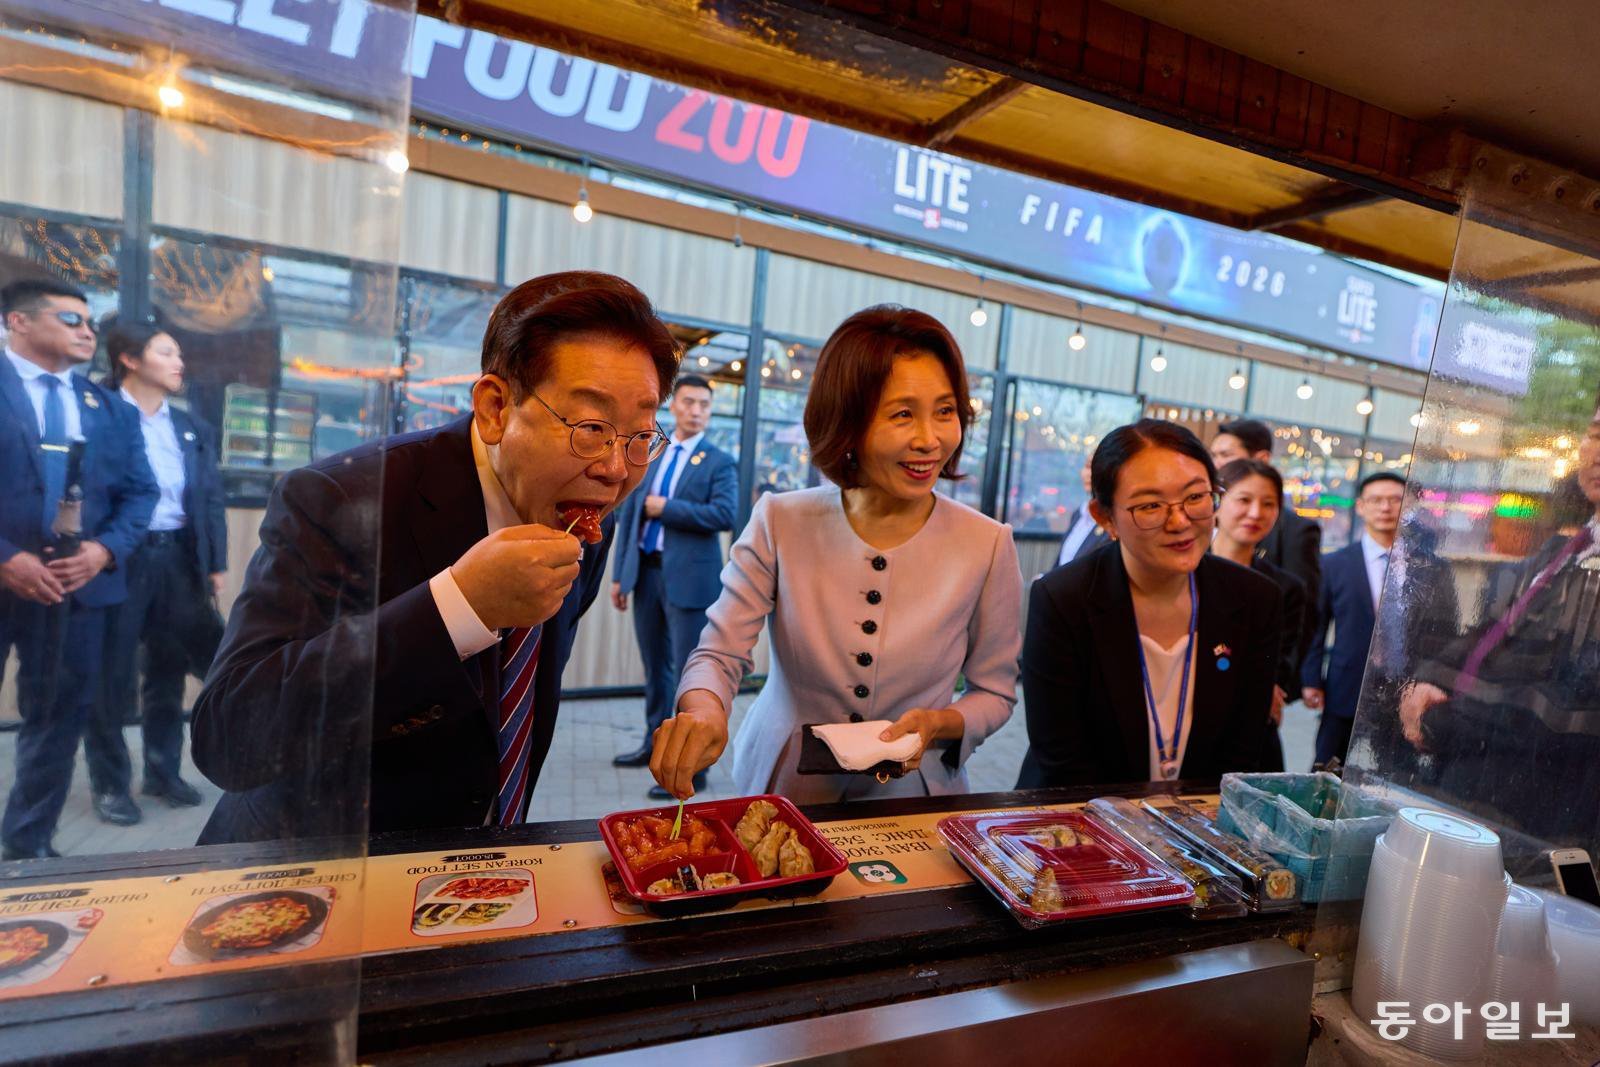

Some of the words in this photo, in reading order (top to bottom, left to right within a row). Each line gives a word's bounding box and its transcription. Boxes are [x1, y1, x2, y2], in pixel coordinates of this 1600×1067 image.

[894, 147, 972, 215] LITE
[1020, 194, 1103, 245] FIFA
[1216, 255, 1286, 297] 2026
[1337, 288, 1378, 332] LITE
[871, 828, 929, 843] ДАНС:
[885, 841, 933, 855] IBAN
[407, 865, 448, 875] FOOD
[451, 862, 481, 872] SET
[485, 857, 543, 869] KOREAN
[295, 873, 358, 887] CHEESE
